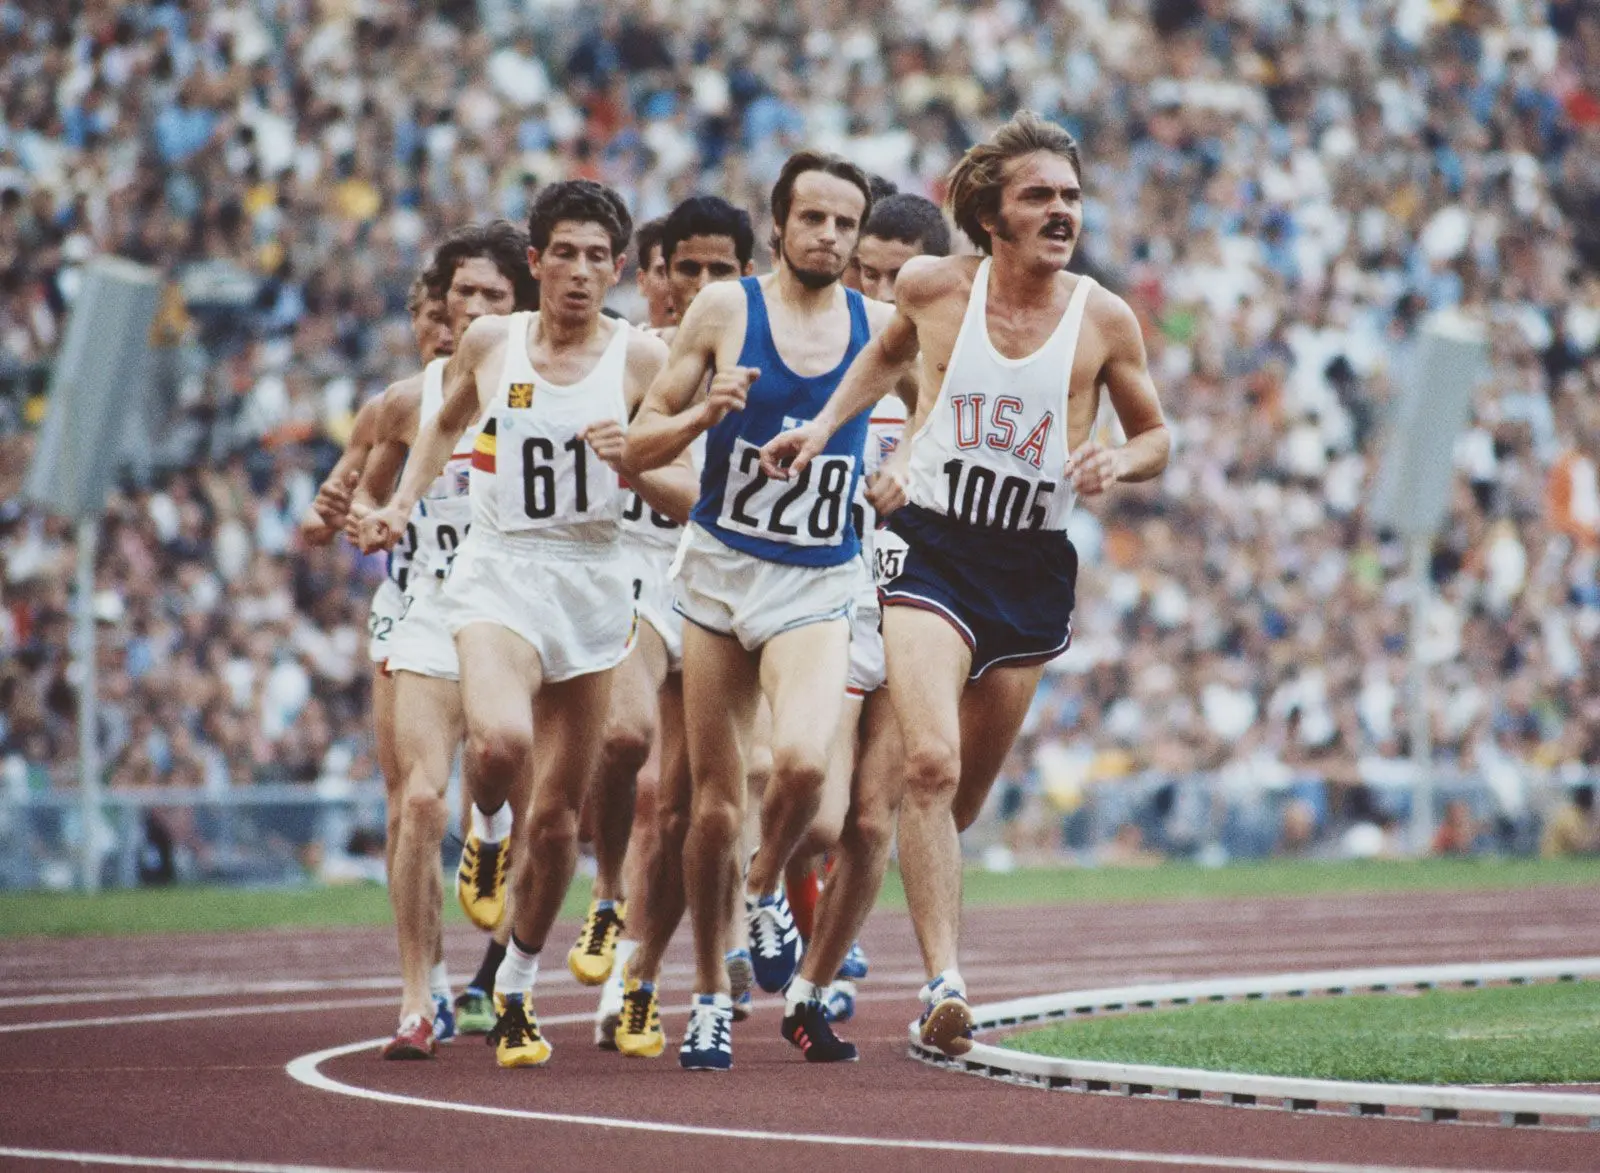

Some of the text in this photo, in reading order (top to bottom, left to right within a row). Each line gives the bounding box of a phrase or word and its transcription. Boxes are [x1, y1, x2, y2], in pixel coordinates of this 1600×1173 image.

[951, 393, 1054, 470] USA
[522, 432, 588, 519] 61
[730, 447, 848, 538] 228
[943, 458, 1056, 529] 1005
